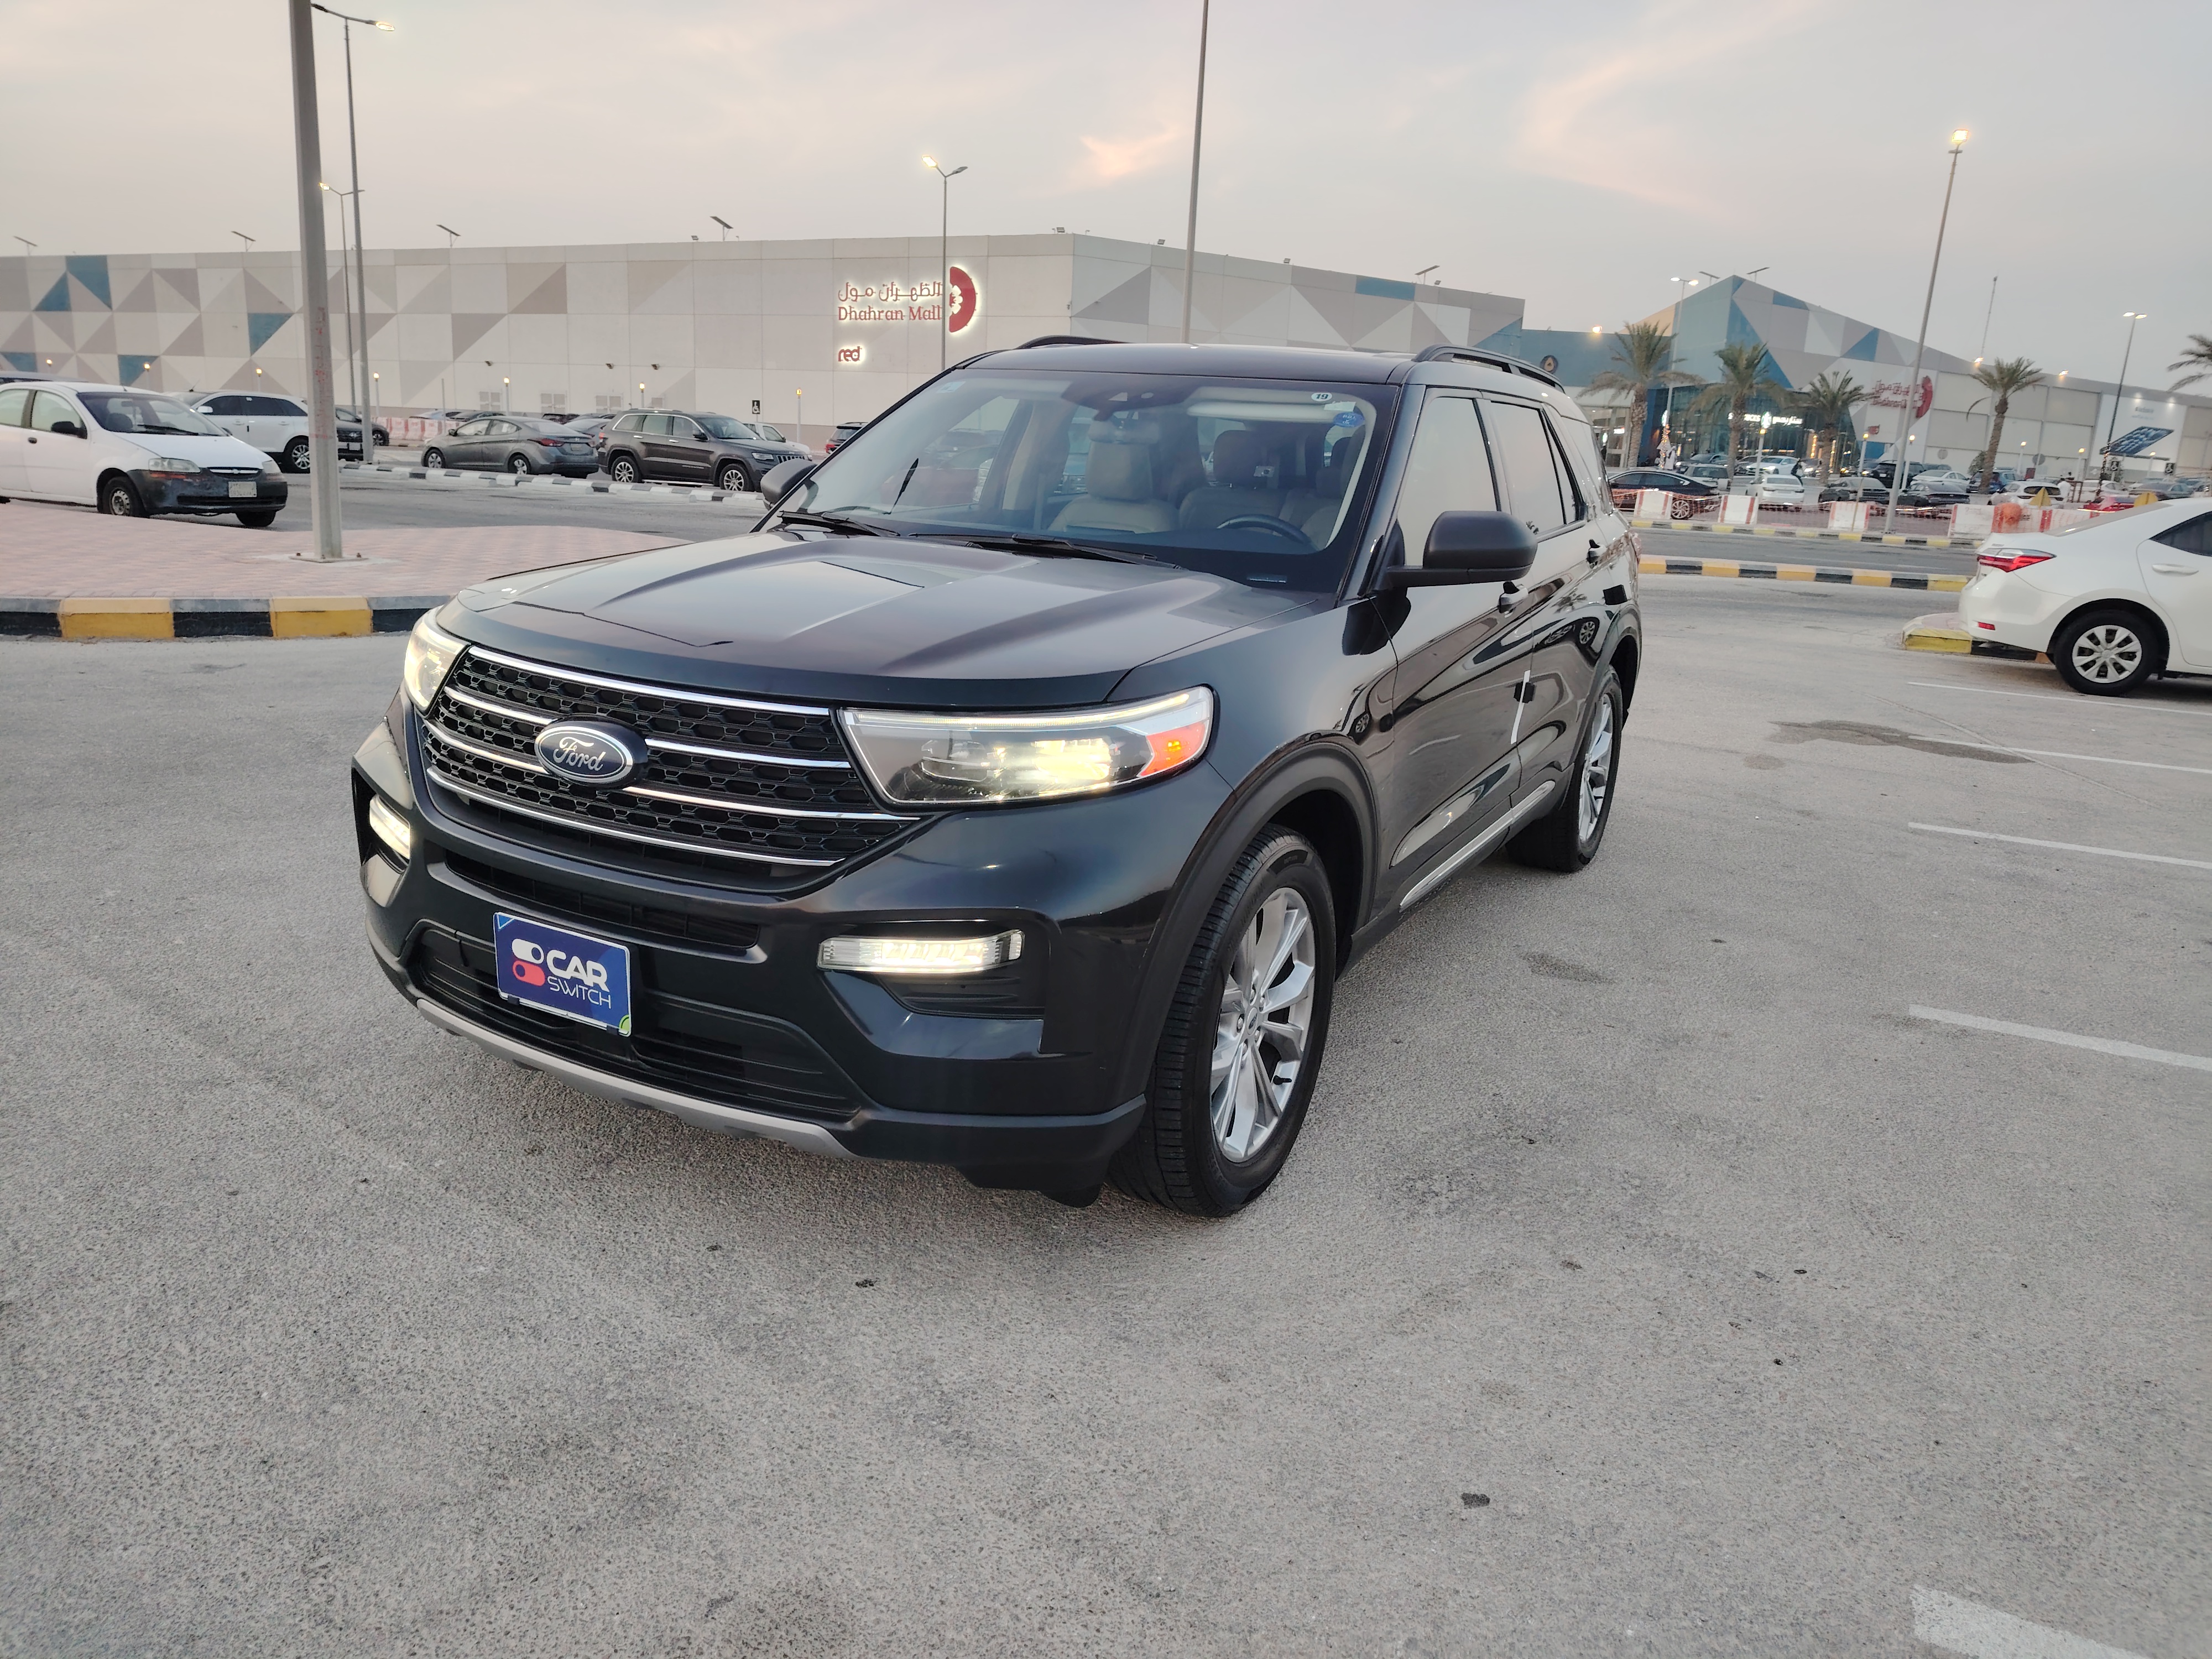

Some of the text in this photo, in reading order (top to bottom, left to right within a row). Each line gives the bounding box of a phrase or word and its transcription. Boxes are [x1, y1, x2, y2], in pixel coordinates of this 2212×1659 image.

[838, 281, 942, 301] الظهران مول
[838, 305, 941, 321] Dhahran Mall
[838, 346, 861, 362] red
[553, 737, 606, 771] Ford
[546, 950, 610, 993] CAR
[547, 976, 612, 1009] SWITCH
